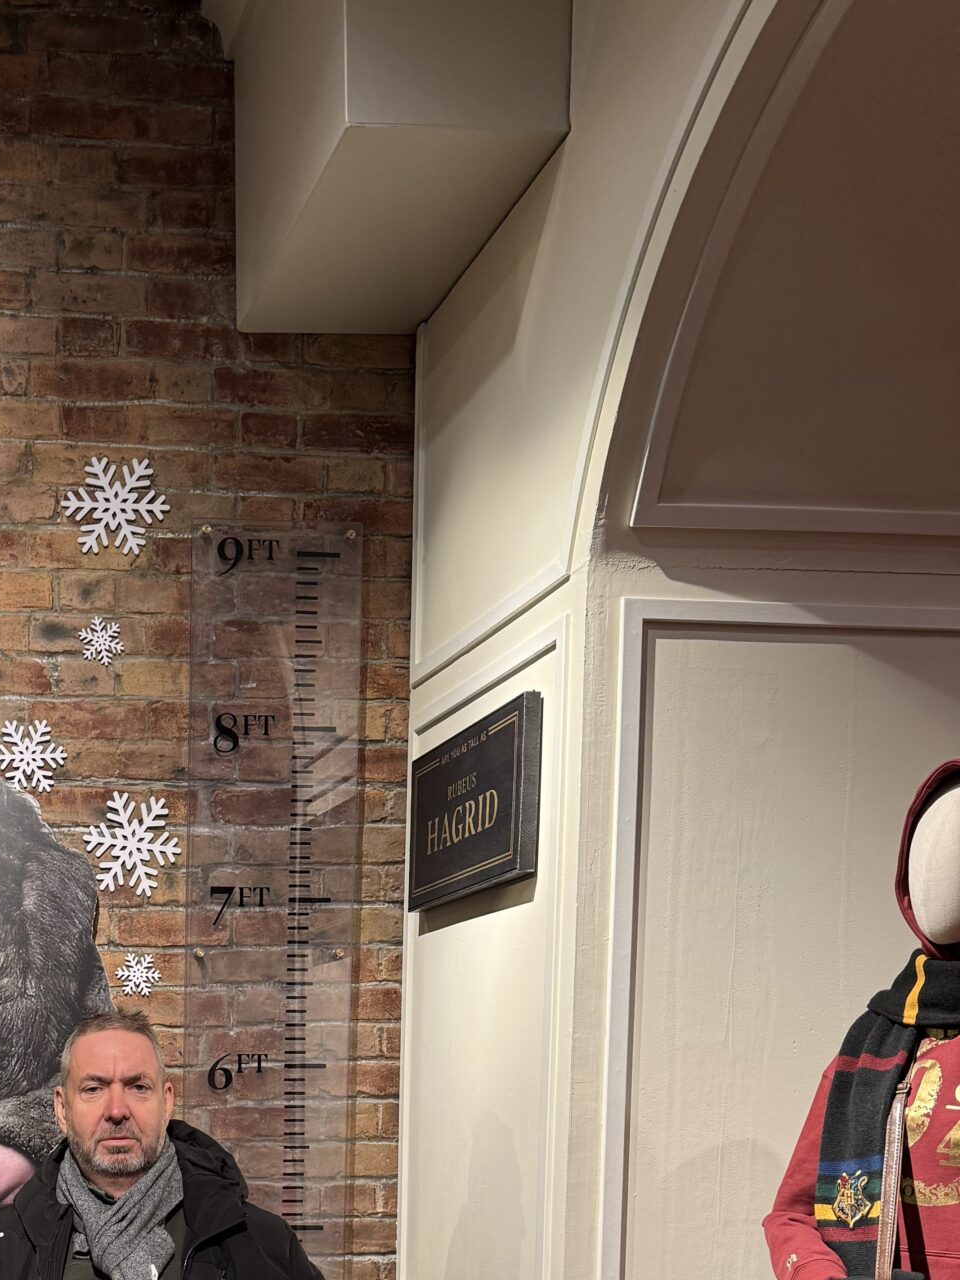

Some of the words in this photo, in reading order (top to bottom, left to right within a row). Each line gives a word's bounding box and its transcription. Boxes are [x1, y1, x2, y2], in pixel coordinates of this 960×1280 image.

[217, 536, 280, 576] 9FT
[213, 712, 276, 753] 8FT
[468, 736, 479, 750] TALL
[447, 772, 477, 801] RUBEUS
[426, 789, 499, 856] HAGRID
[209, 886, 271, 926] 7FT
[207, 1052, 269, 1090] 6FT
